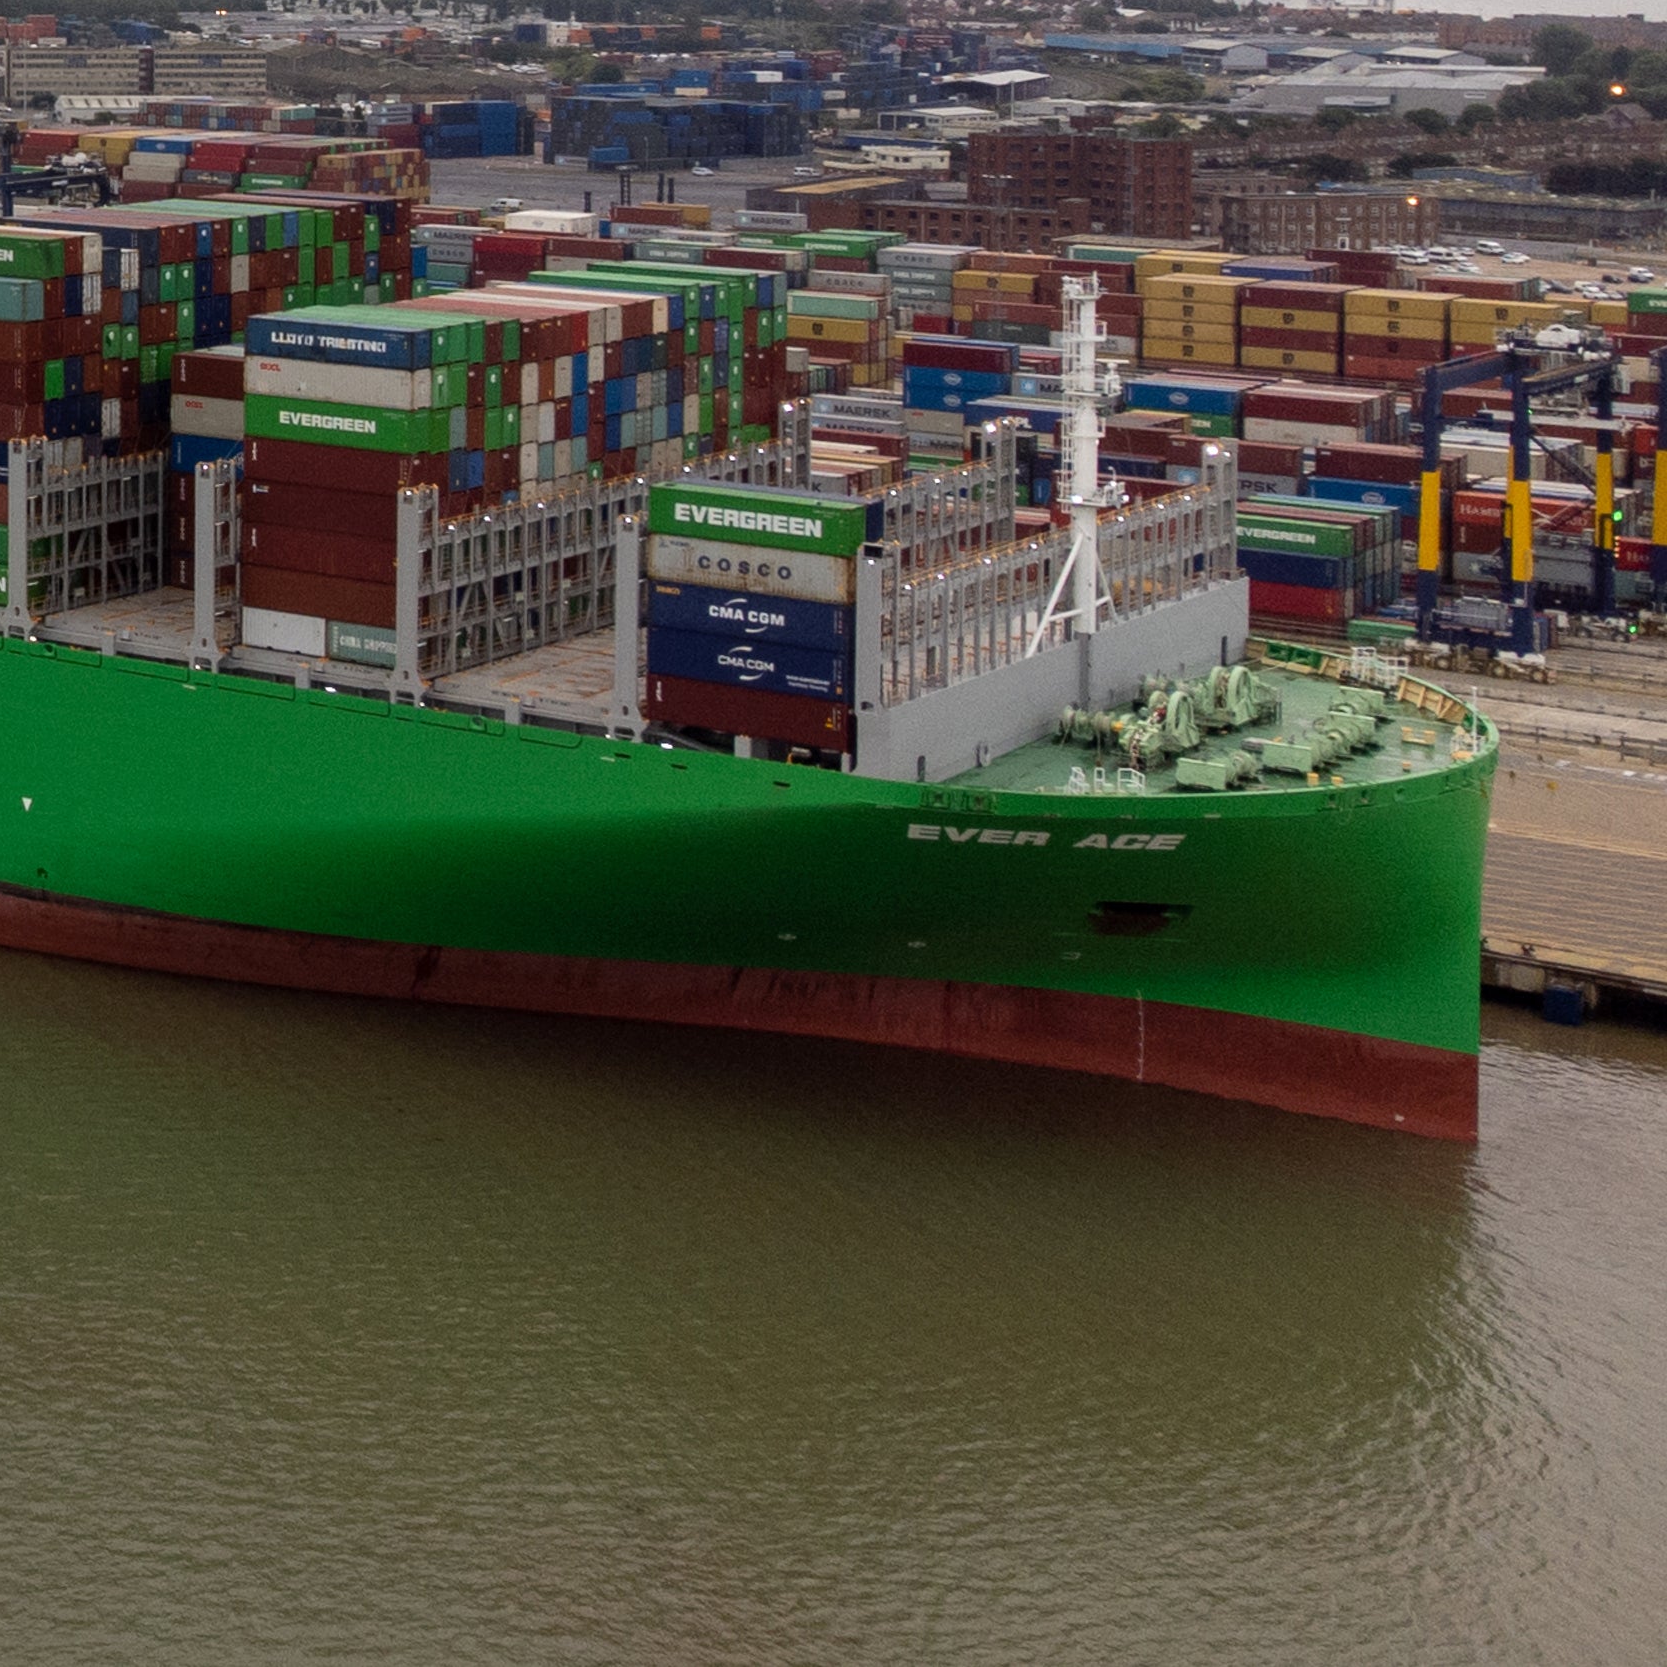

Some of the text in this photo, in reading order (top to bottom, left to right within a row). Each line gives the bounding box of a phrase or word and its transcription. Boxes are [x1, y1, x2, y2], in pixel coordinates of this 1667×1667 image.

[750, 216, 793, 226] MAERSK
[270, 330, 387, 354] LLOYD TRIESTINO
[279, 410, 376, 434] EVERGREEN
[833, 404, 891, 418] MAERSK
[674, 502, 823, 539] EVERGREEN
[698, 554, 792, 580] COSCO
[708, 604, 786, 627] CMA CGM
[717, 654, 775, 673] CMA CGM
[907, 823, 1187, 850] EVER ACE
